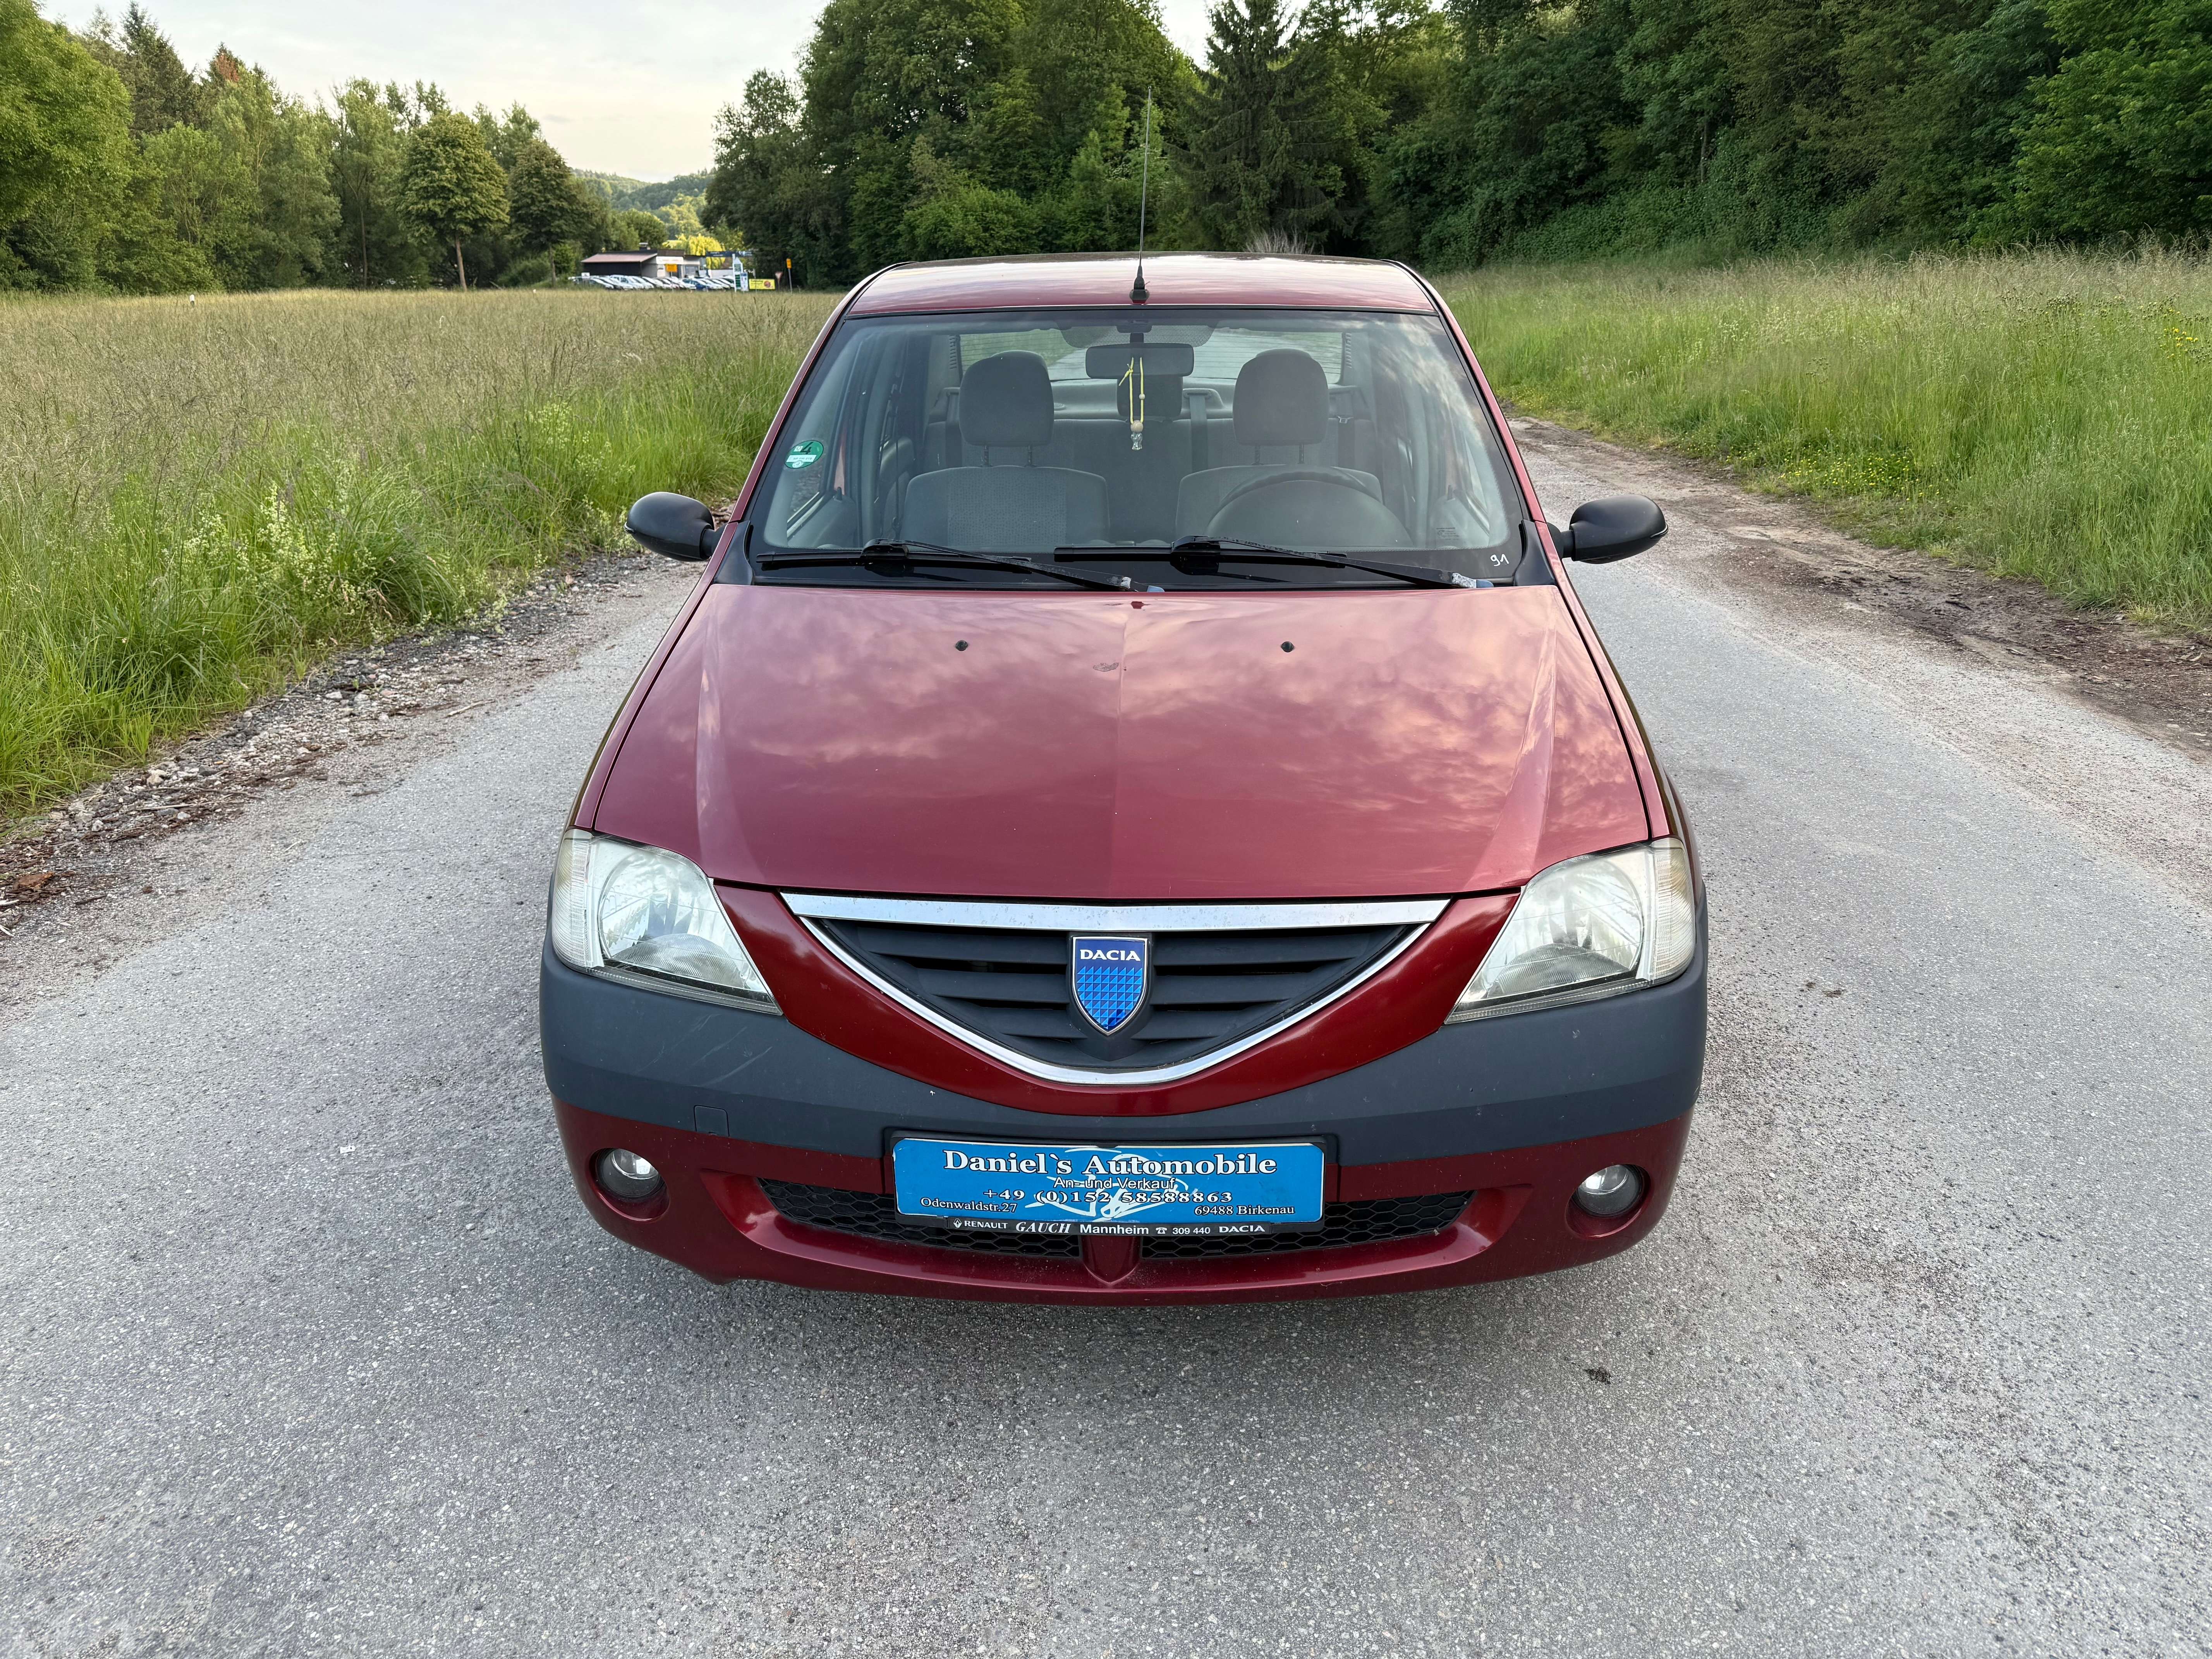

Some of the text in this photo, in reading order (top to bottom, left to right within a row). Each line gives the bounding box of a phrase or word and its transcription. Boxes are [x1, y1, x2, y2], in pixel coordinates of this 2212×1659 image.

[800, 442, 814, 454] 4
[1080, 949, 1141, 961] DACIA
[1082, 1153, 1277, 1175] Automobile
[1054, 1176, 1176, 1190] An- und Verkauf
[983, 1189, 1232, 1204] +49 (0)152 58588863
[920, 1197, 1018, 1213] Odenwaldstr.27
[1194, 1205, 1295, 1216] 69488 Birkenau
[964, 1220, 1008, 1230] RENAULT
[1015, 1221, 1072, 1234] GAUCH
[1080, 1224, 1149, 1235] Mannheim
[1219, 1224, 1266, 1233] DACIA
